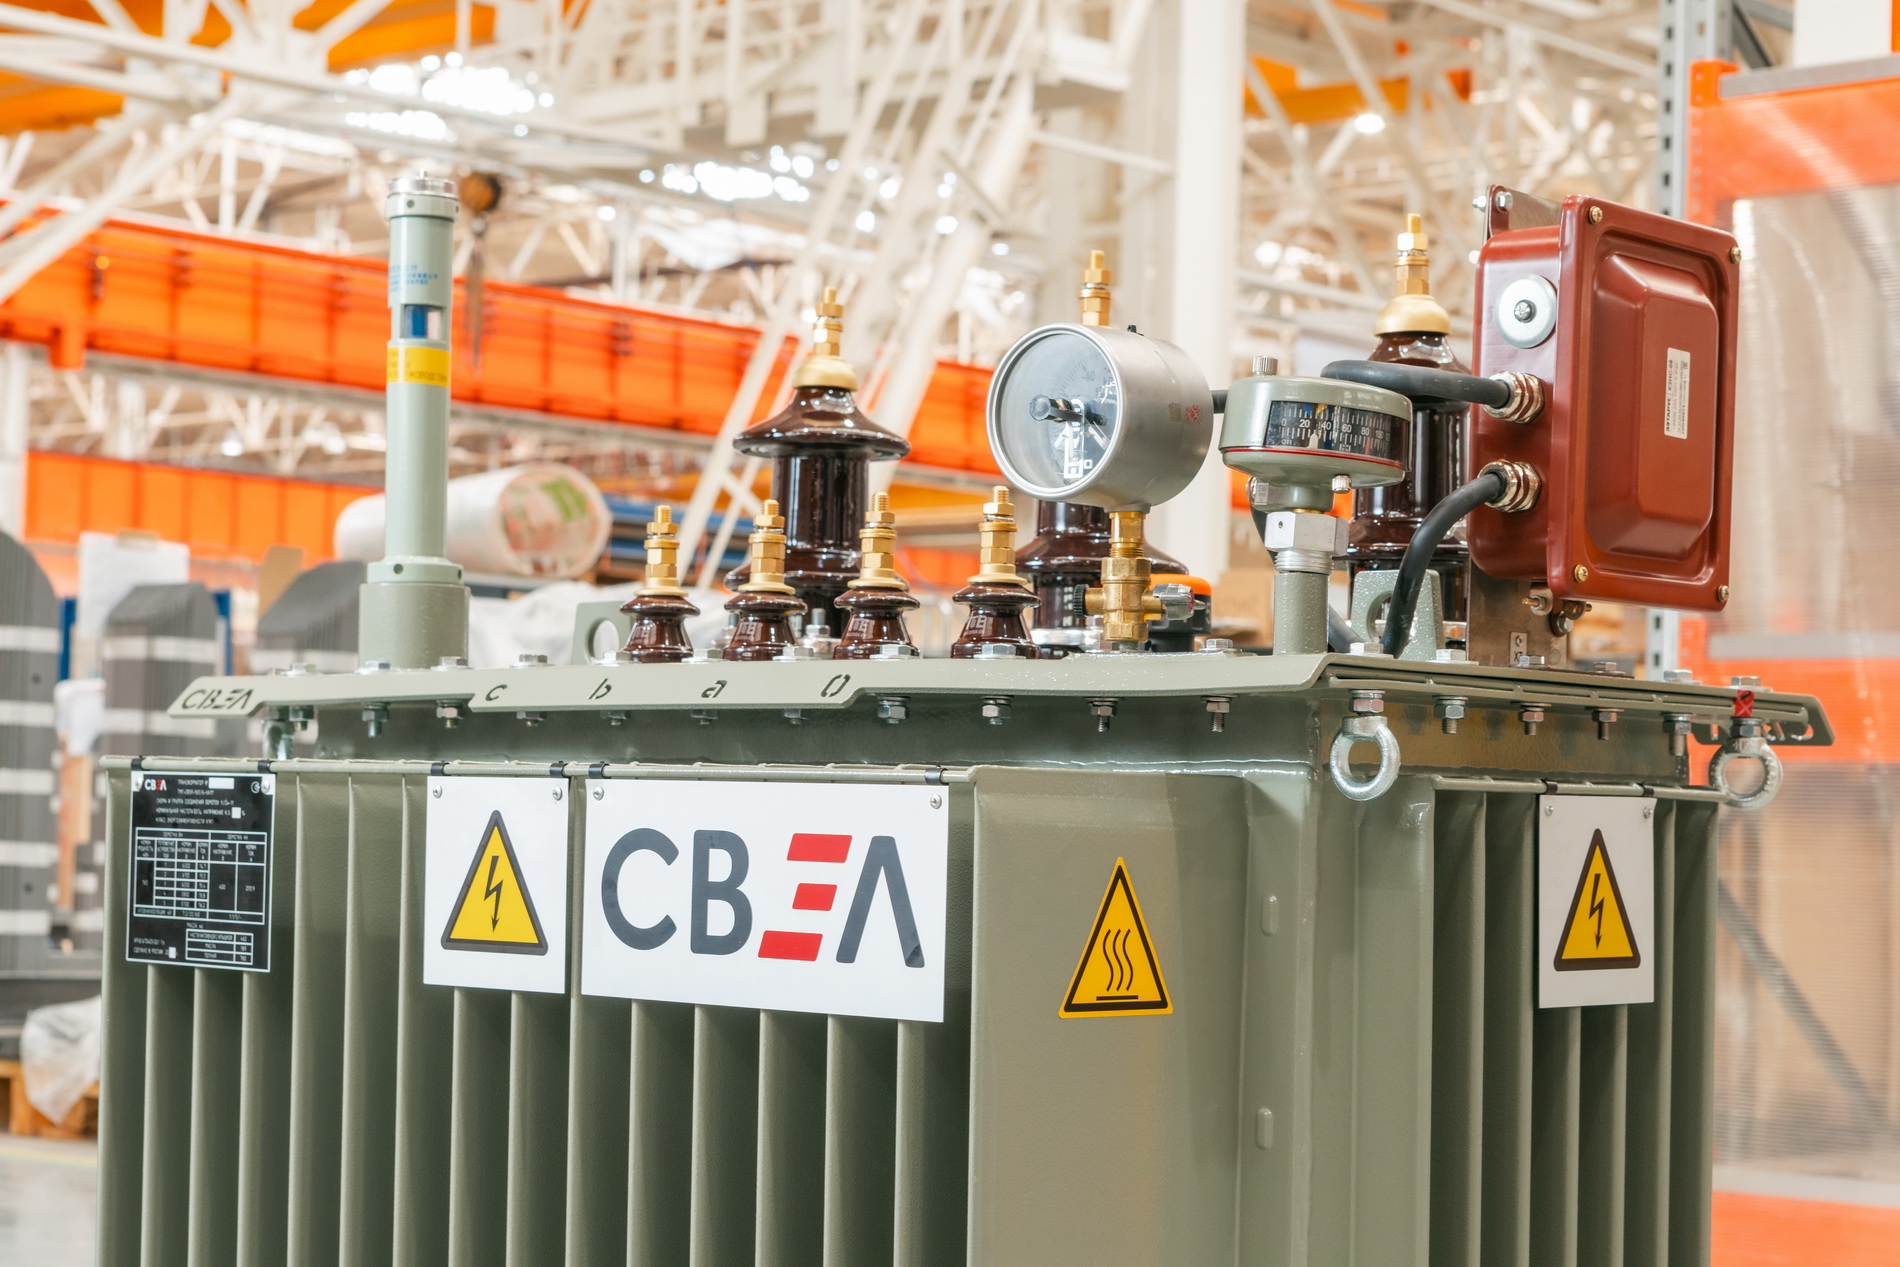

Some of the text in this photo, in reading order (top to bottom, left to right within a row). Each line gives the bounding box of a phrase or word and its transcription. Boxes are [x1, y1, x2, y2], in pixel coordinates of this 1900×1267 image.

[1299, 419, 1310, 428] 20
[1321, 421, 1332, 430] 40
[1341, 423, 1352, 433] 60
[1361, 426, 1370, 436] 80
[588, 678, 612, 700] b
[701, 679, 728, 698] a
[144, 779, 166, 790] СВЭЛ
[601, 827, 925, 968] СВЭЛ
